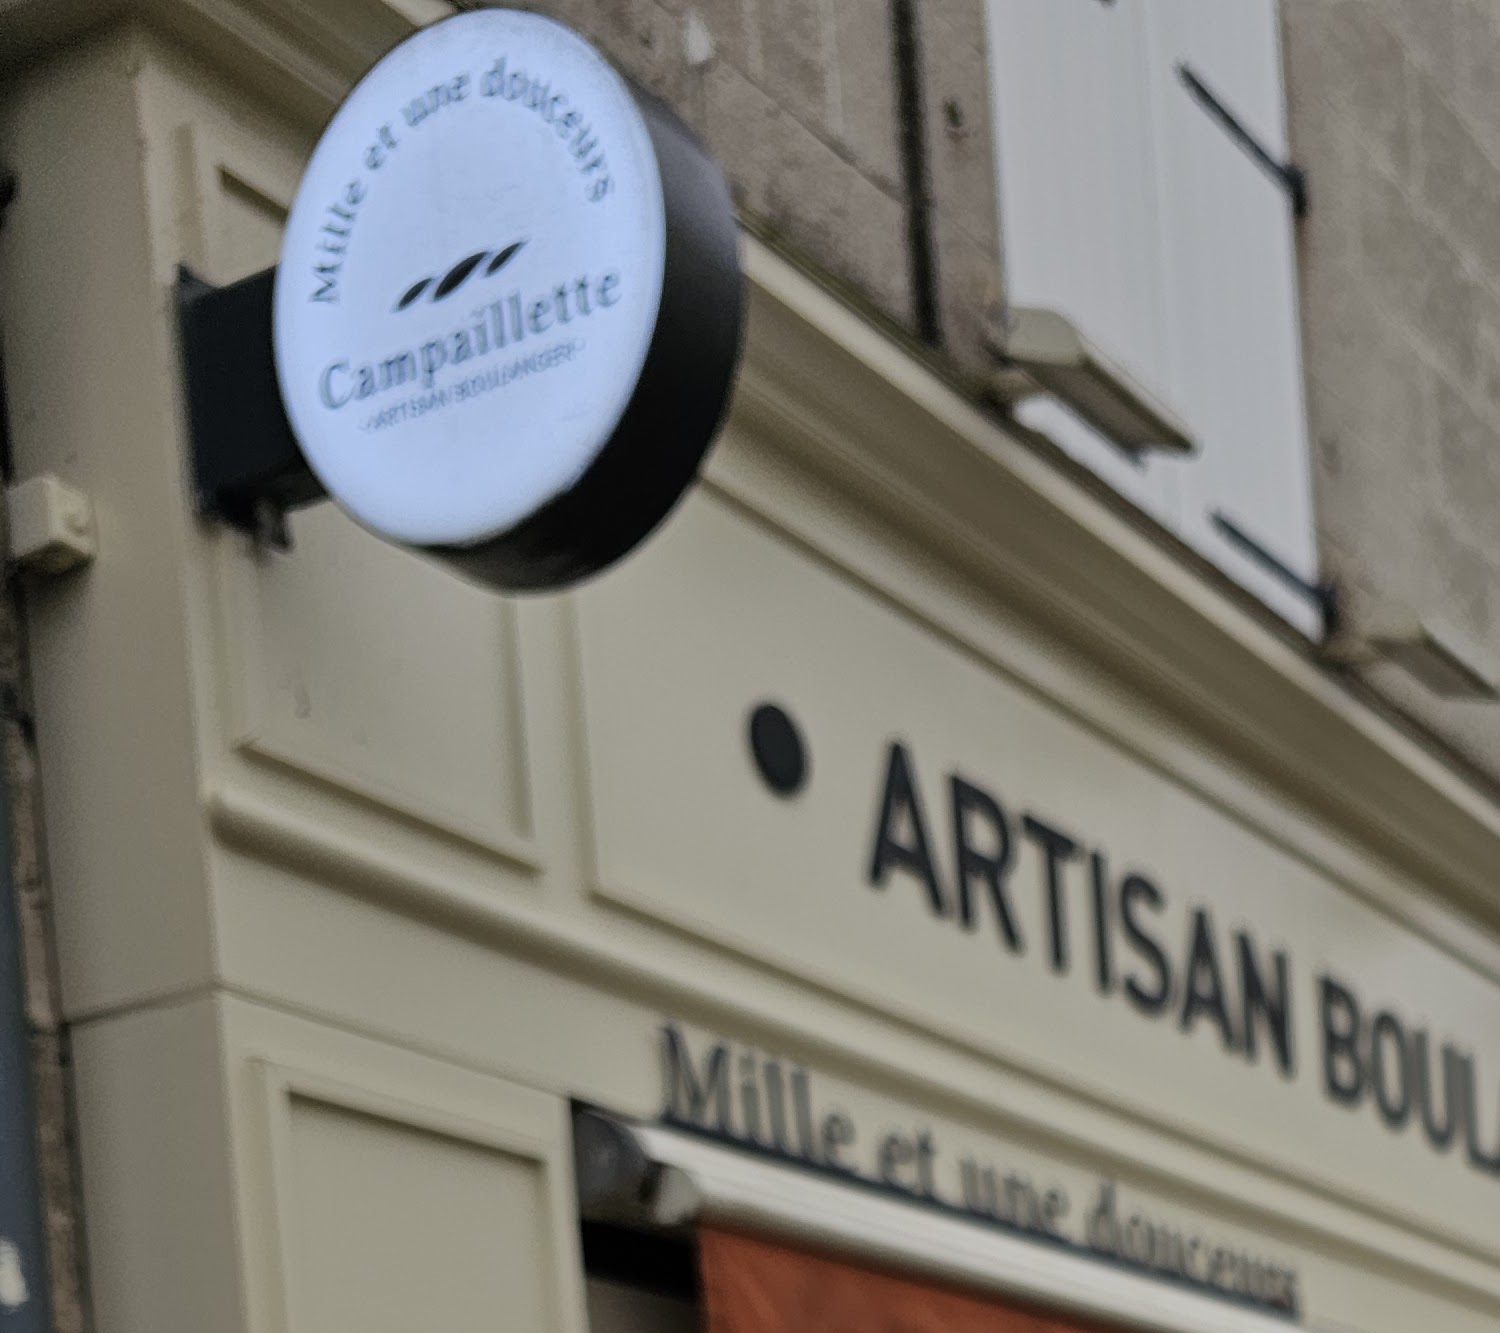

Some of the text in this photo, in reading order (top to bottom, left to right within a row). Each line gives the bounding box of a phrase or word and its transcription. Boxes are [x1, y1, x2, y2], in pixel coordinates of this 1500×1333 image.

[310, 56, 614, 304] Mille et une douceurs
[318, 271, 622, 411] Campaillette
[864, 736, 1299, 1082] ARTISAN
[655, 1020, 858, 1175] Mille
[877, 1126, 941, 1202] et
[958, 1155, 1073, 1246] une
